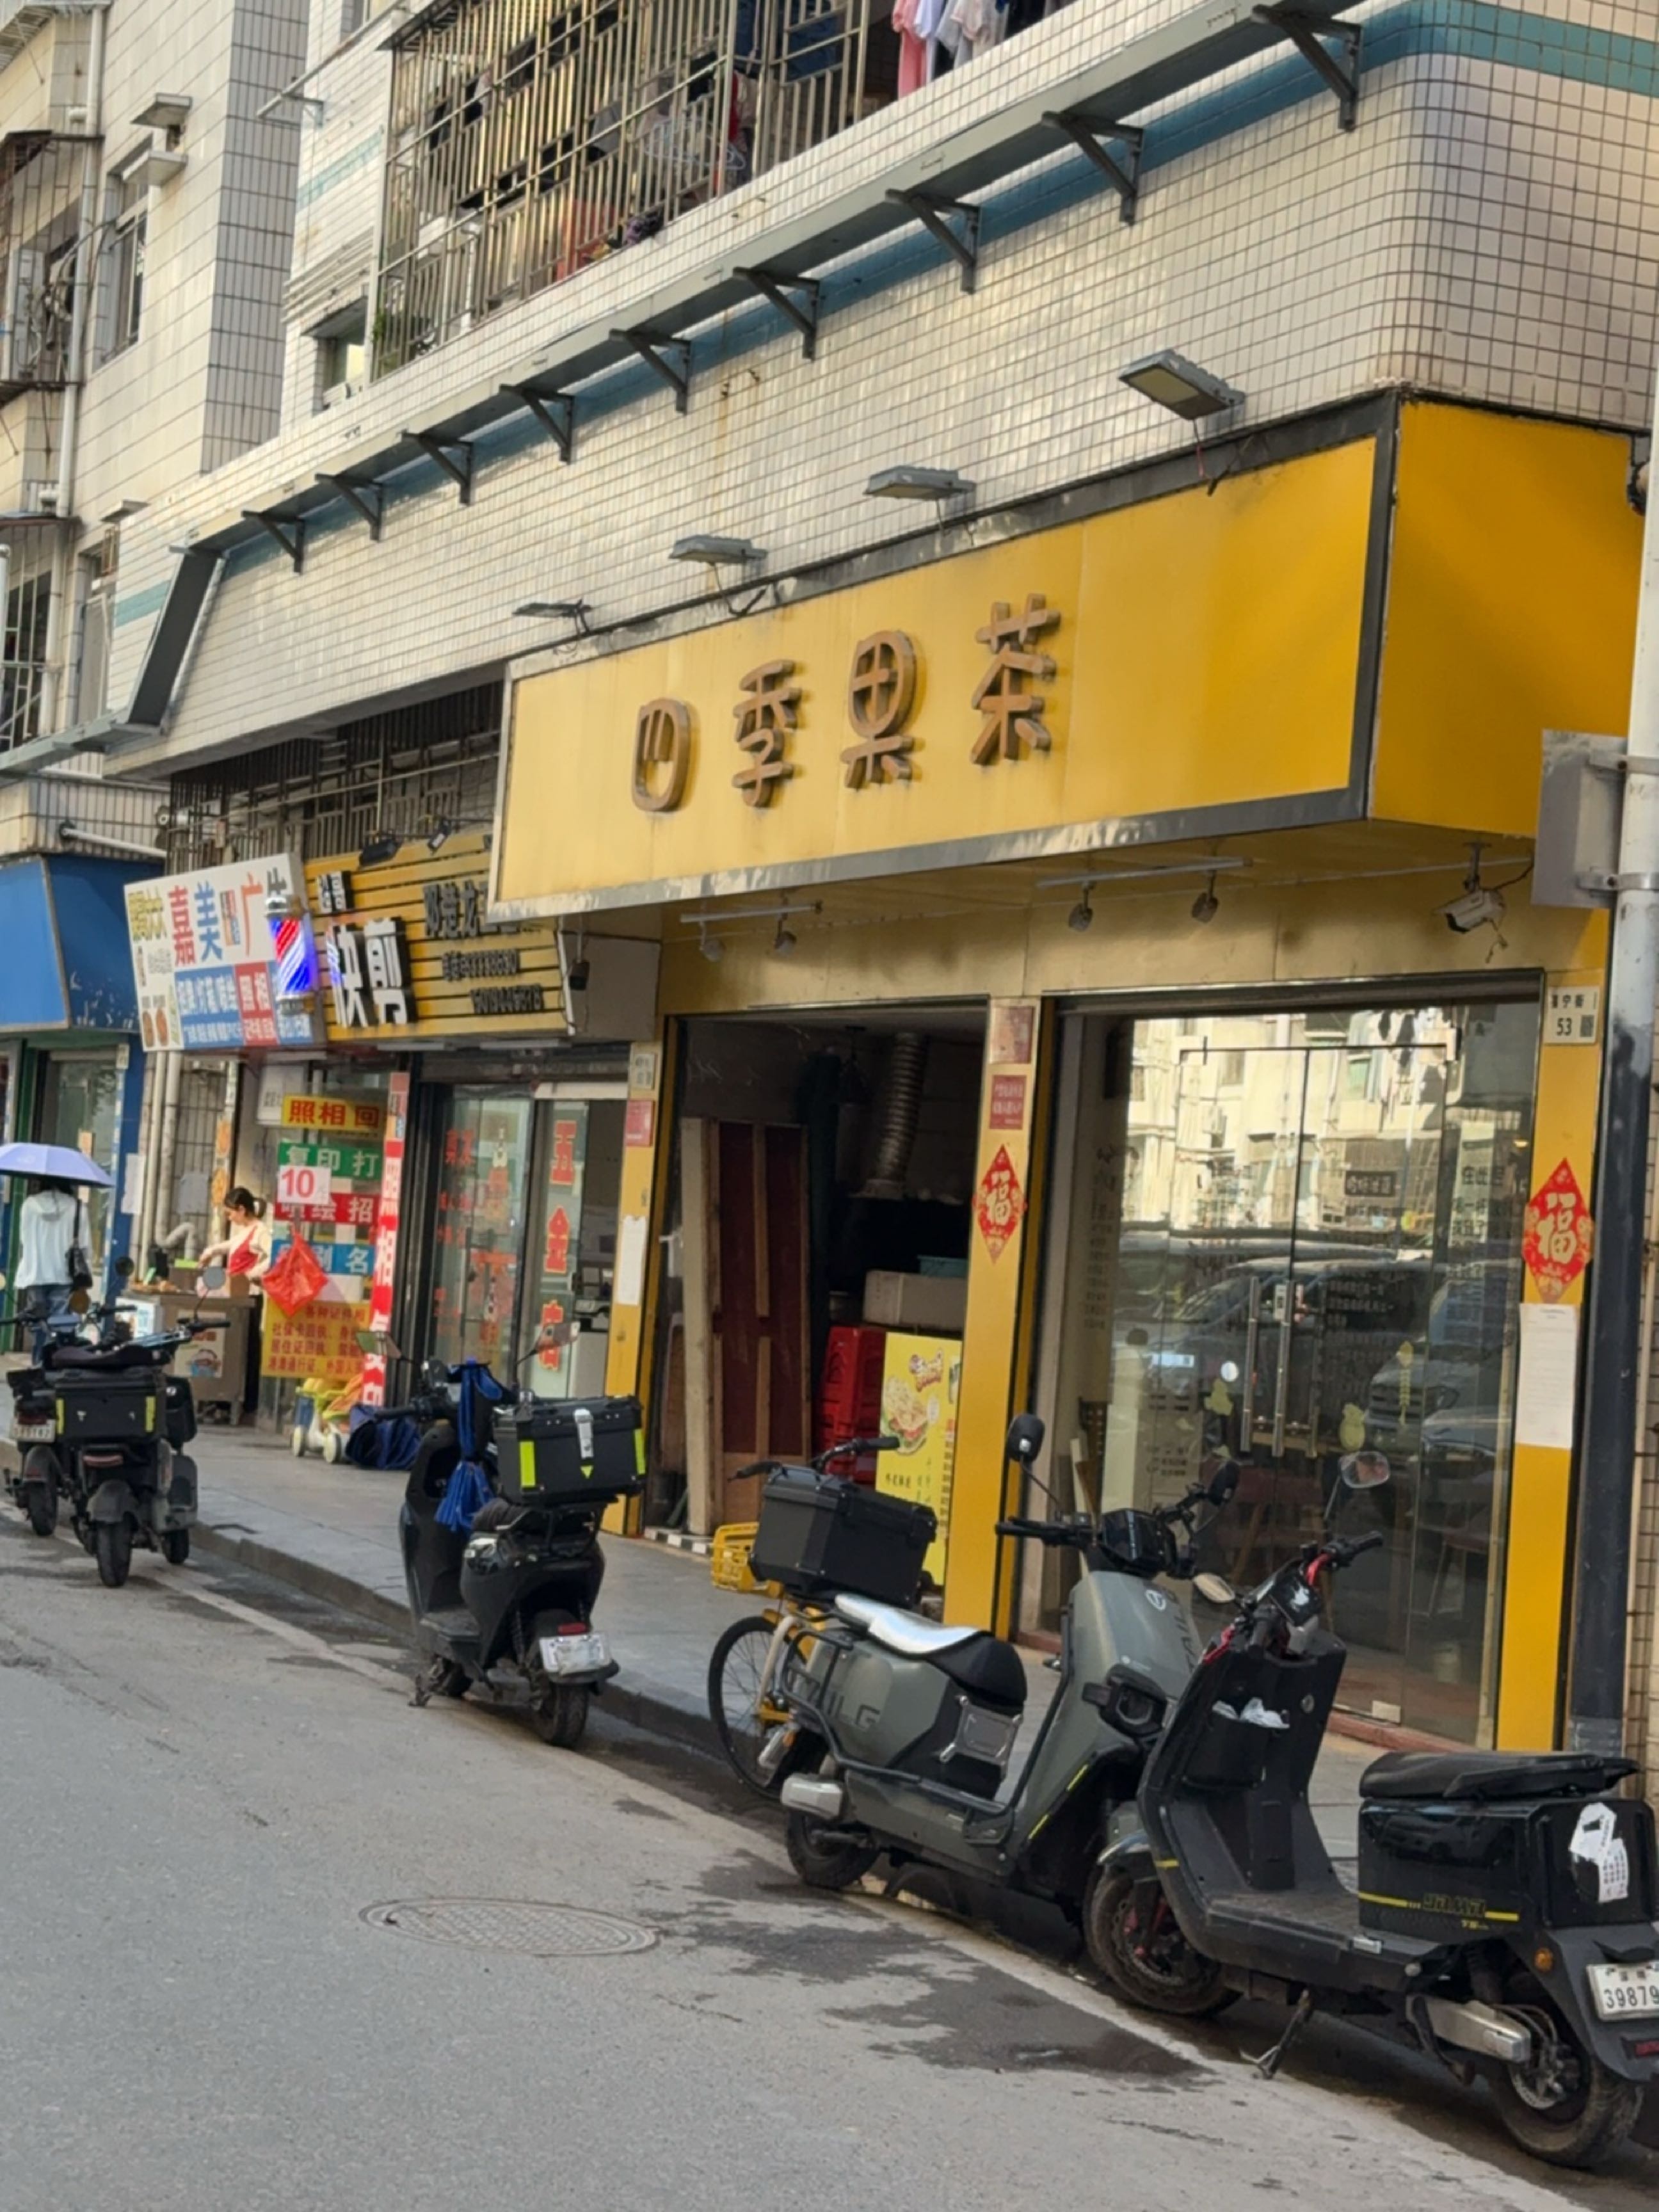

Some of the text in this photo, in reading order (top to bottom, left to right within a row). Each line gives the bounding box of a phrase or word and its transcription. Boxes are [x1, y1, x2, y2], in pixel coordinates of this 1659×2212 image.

[631, 593, 1061, 813] 四季果茶
[325, 917, 410, 1029] 快剪
[1557, 1017, 1572, 1036] 53
[282, 1169, 314, 1198] 10
[1537, 1192, 1578, 1265] 福
